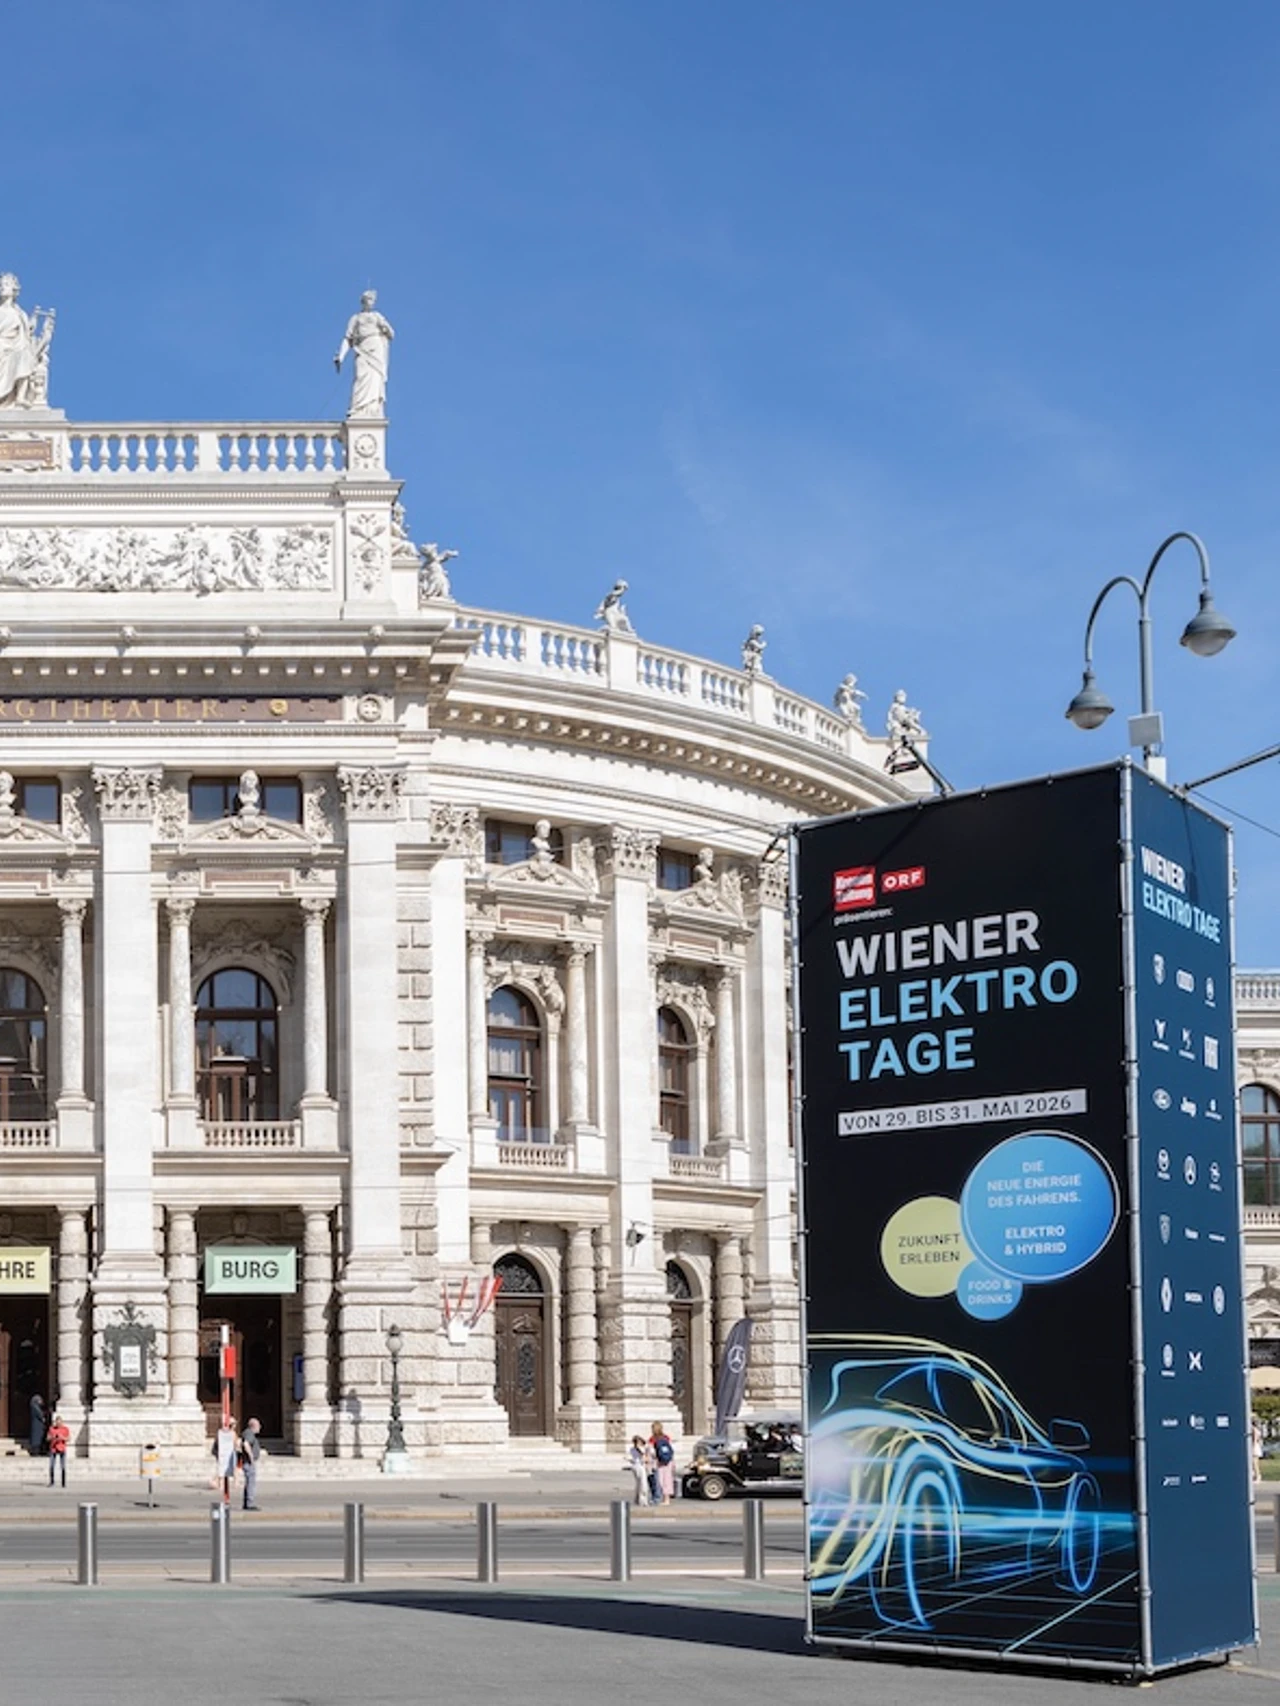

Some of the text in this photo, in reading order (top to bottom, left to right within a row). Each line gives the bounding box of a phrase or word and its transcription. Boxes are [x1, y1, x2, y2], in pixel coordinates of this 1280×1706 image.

[1141, 846, 1186, 894] WIENER
[883, 871, 921, 889] ORF
[1143, 881, 1221, 943] ELEKTRO TAGE
[836, 911, 1040, 978] WIENER
[840, 960, 1077, 1030] ELEKTRO
[838, 1027, 974, 1081] TAGE
[843, 1095, 1071, 1131] VON 29. BIS 31. MAI 2026
[1022, 1160, 1044, 1173] DIE
[987, 1174, 1082, 1192] NEUE ENERGIE
[987, 1191, 1082, 1208] DES FAHRENS.
[898, 1233, 960, 1248] ZUKUNFT
[1004, 1224, 1066, 1240] ELEKTRO
[1004, 1240, 1067, 1256] & HYBRID
[899, 1251, 960, 1265] ERLEBEN
[222, 1261, 279, 1279] BURG
[968, 1279, 1012, 1291] FOOD &
[967, 1293, 1013, 1306] DRINKS
